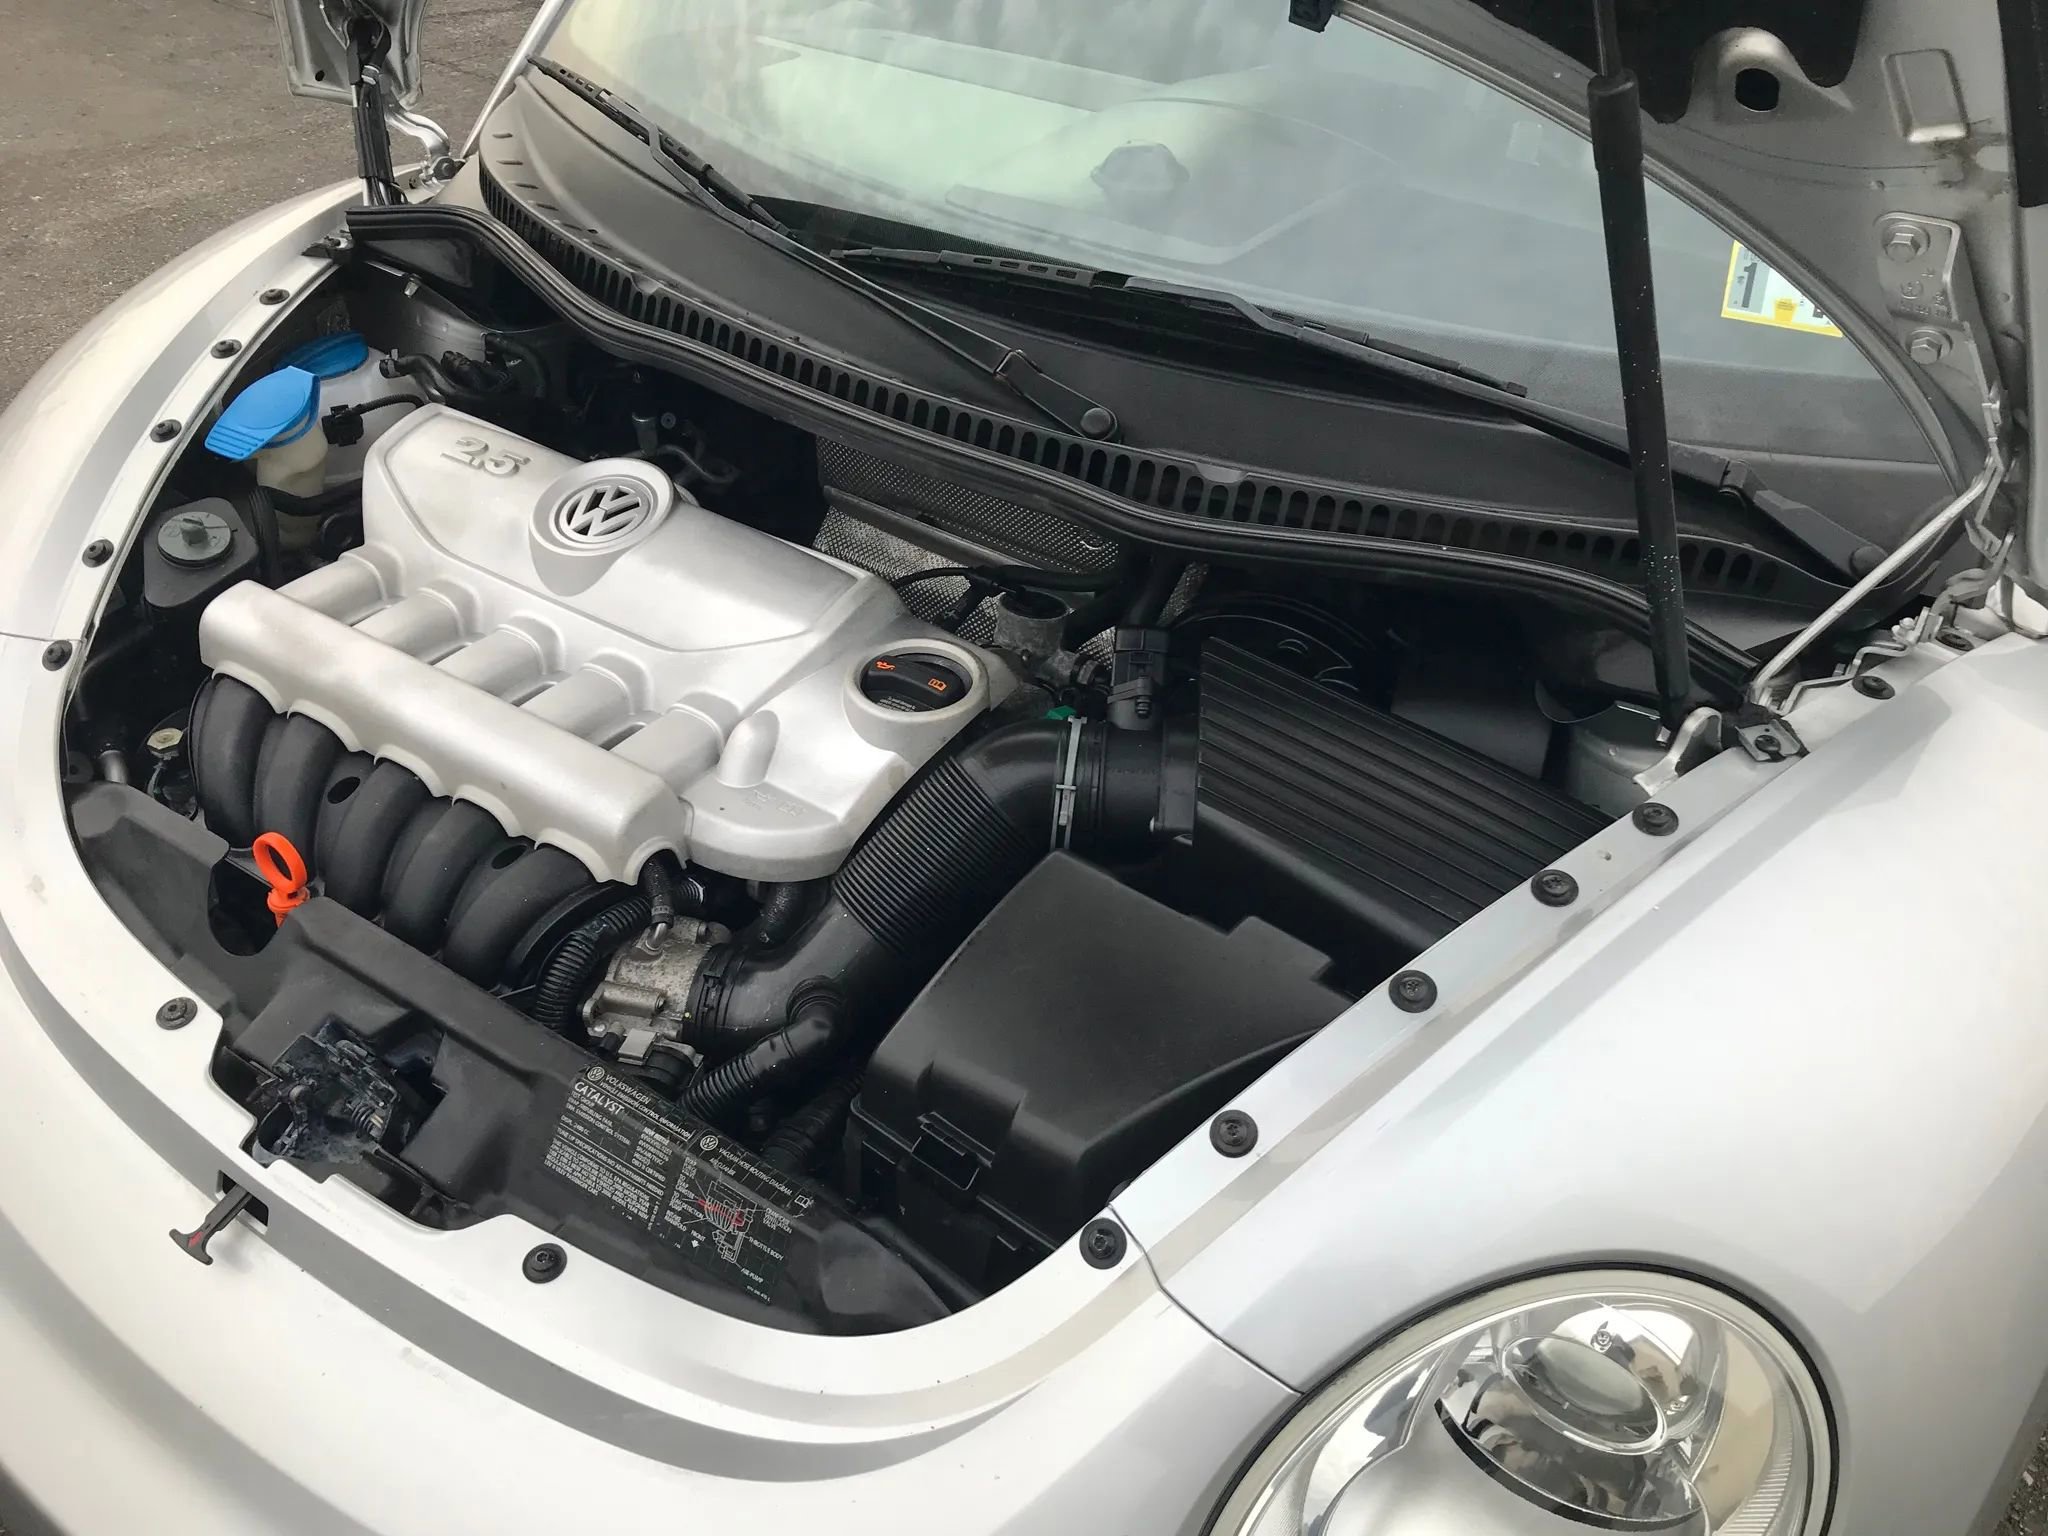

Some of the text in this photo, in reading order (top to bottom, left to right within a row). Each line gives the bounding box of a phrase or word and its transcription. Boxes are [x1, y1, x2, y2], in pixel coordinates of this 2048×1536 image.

[573, 1079, 625, 1117] CATALYST
[605, 1073, 651, 1105] VOLKSWAGEN
[637, 1103, 660, 1120] CONTROL
